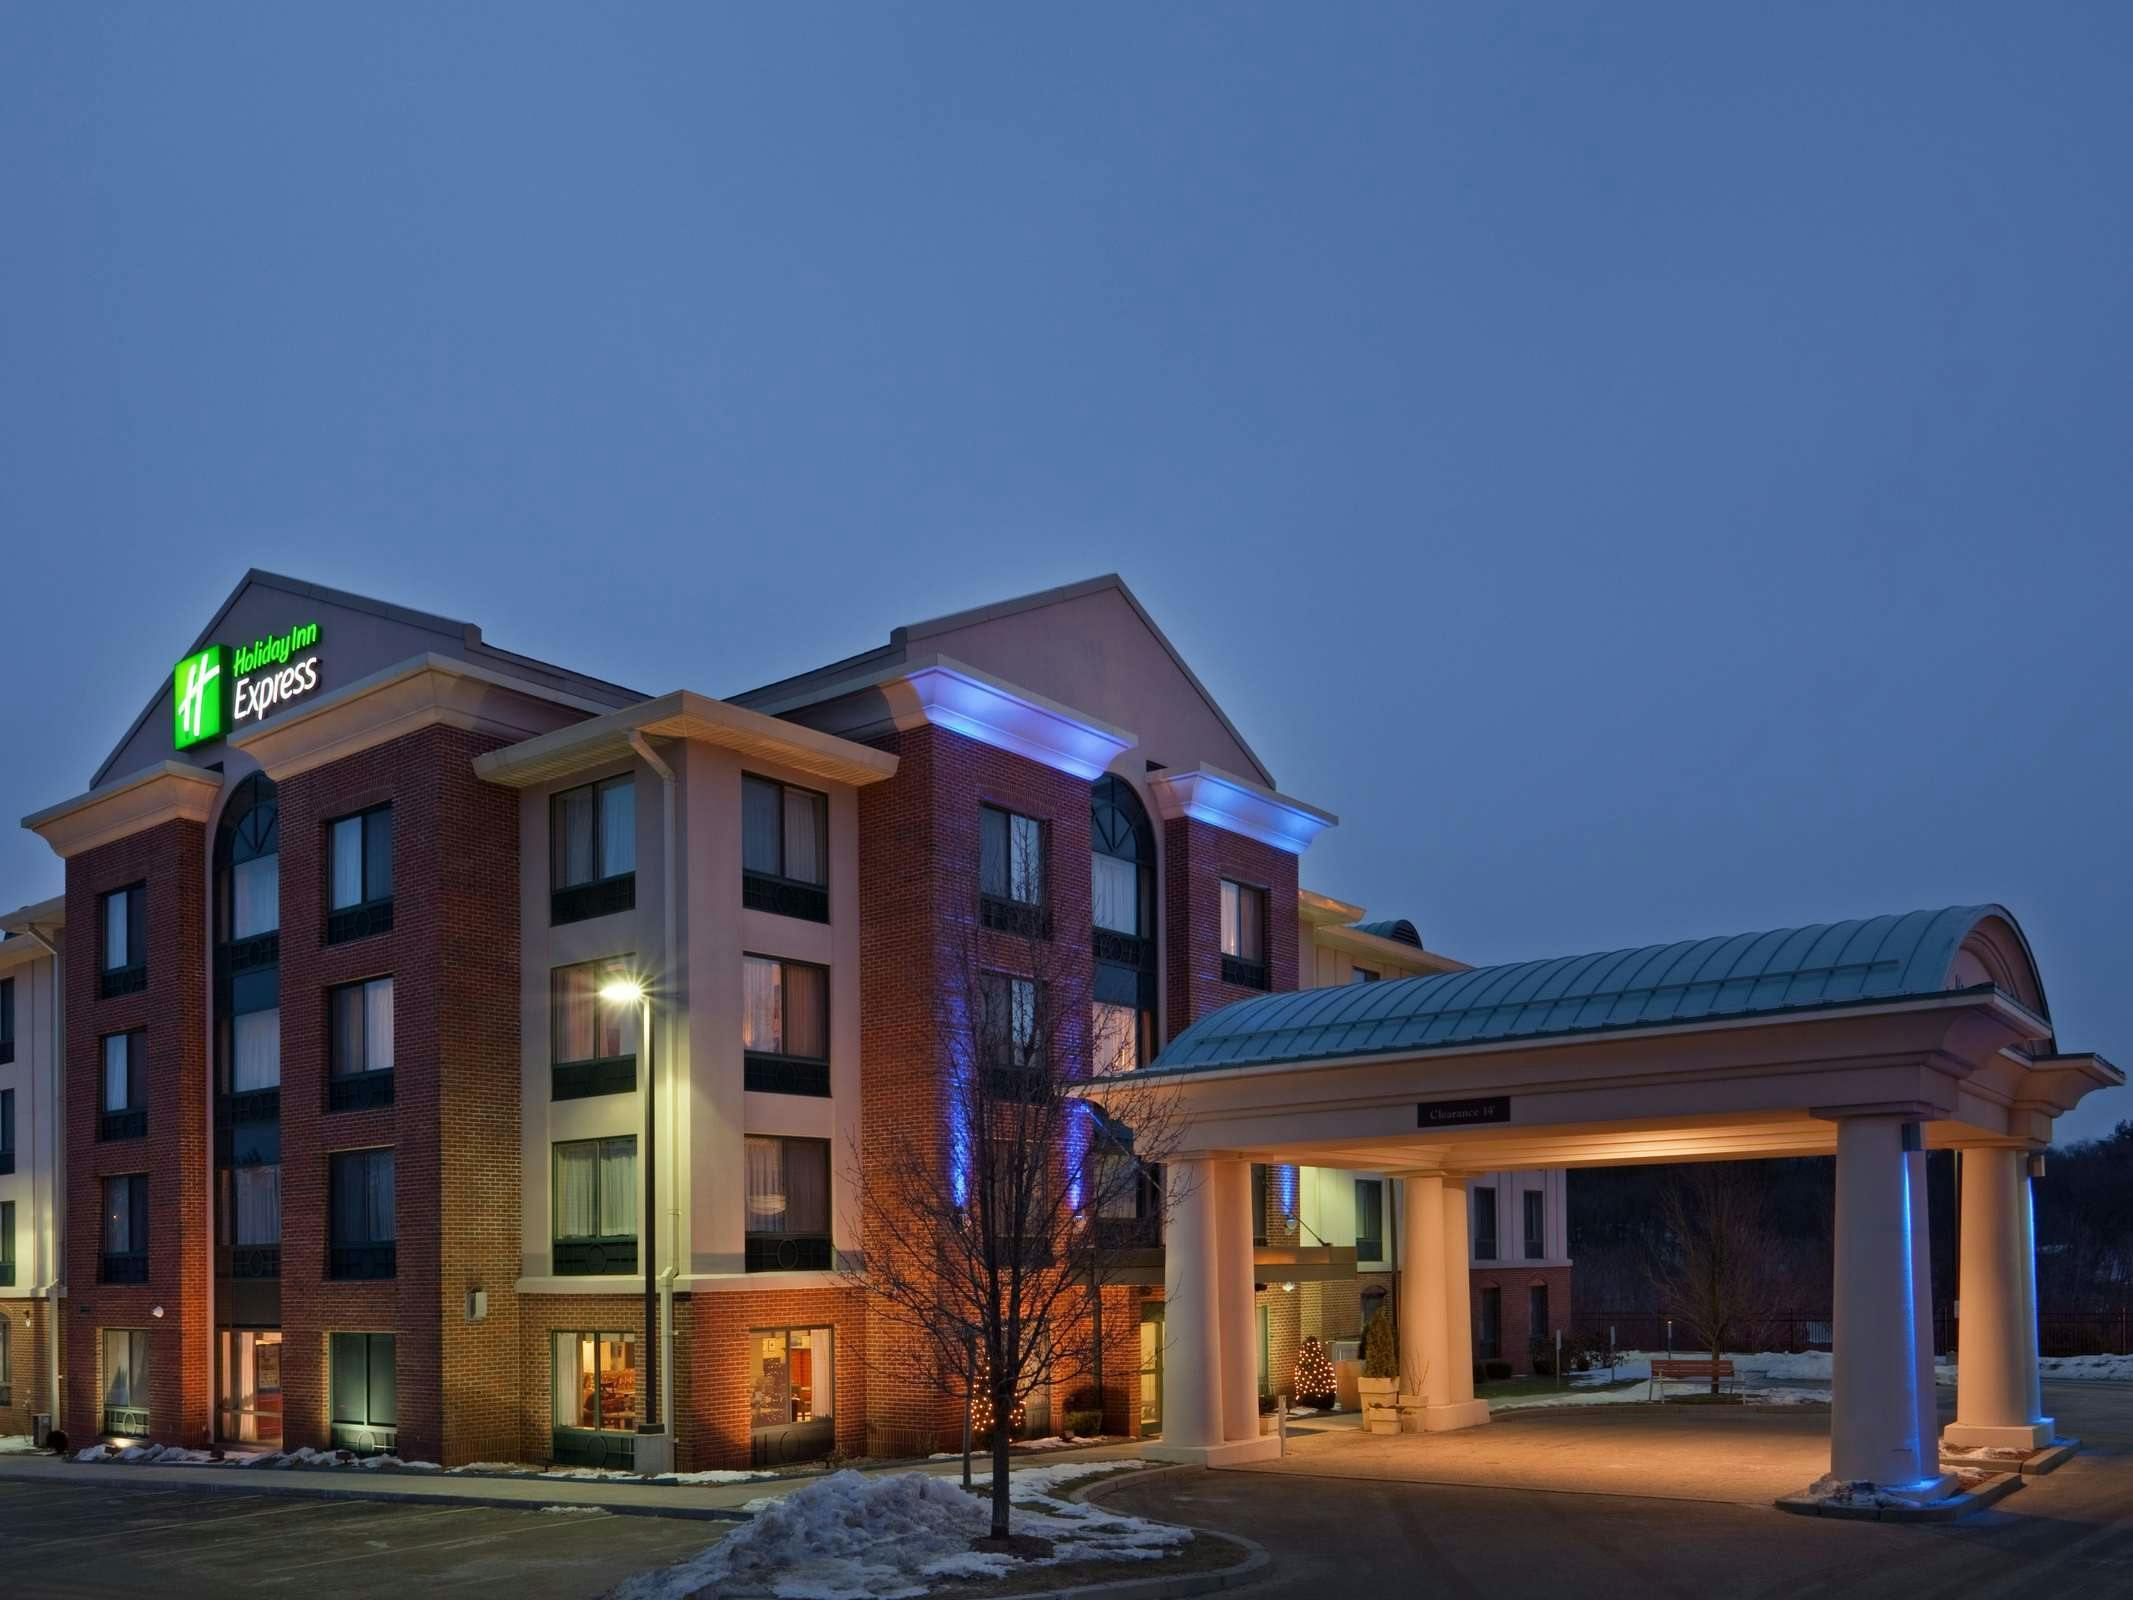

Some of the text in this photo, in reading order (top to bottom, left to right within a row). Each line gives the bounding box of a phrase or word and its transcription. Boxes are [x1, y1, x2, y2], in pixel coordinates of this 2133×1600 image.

[233, 623, 318, 677] Holiday Inn
[233, 657, 318, 721] Express
[1430, 1107, 1480, 1120] Clearance
